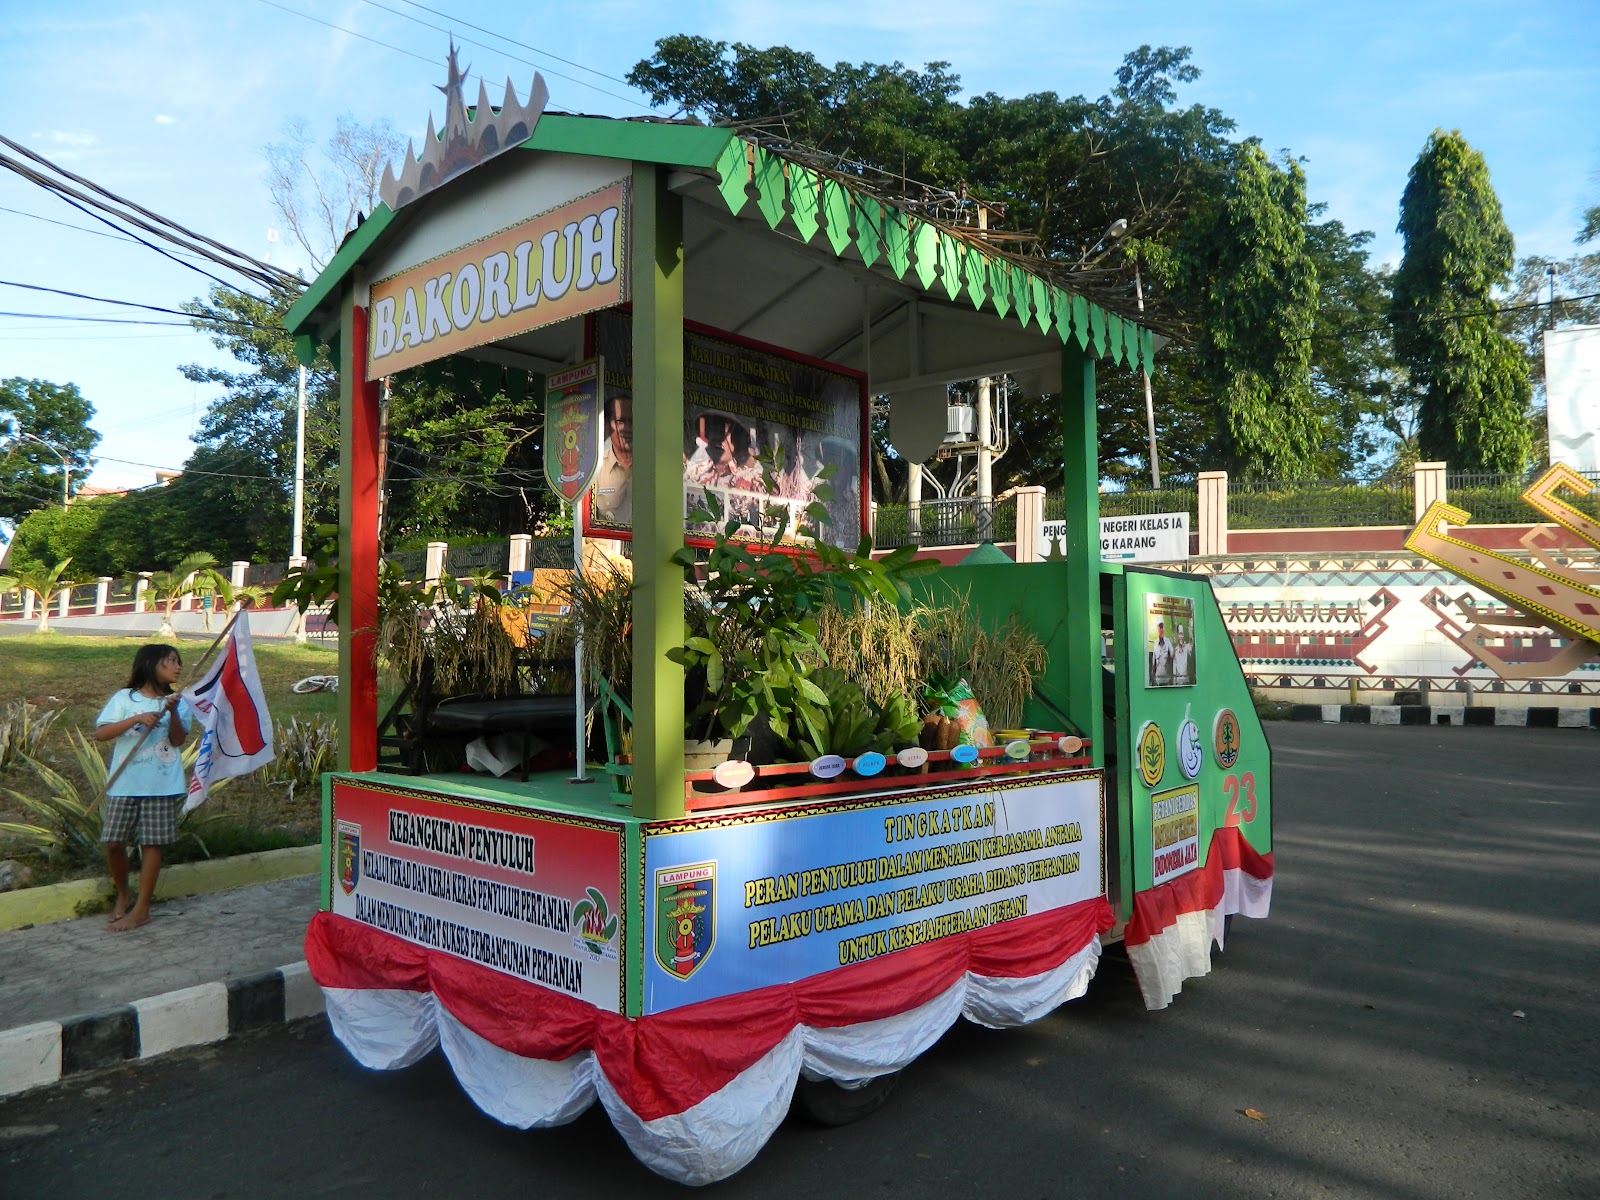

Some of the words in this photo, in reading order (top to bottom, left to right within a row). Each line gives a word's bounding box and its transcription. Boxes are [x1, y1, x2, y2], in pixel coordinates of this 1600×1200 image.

[373, 207, 619, 360] BAKORLUH
[551, 367, 593, 386] LAMPUNG
[690, 345, 713, 364] MARI
[716, 351, 736, 371] KITA
[740, 359, 792, 385] TINGKATKAN
[739, 404, 755, 419] DAN
[780, 392, 794, 406] DAN
[1104, 520, 1137, 533] NEGERI
[1140, 518, 1169, 531] KELAS
[1172, 517, 1182, 529] IA
[1112, 536, 1156, 550] KARANG
[884, 802, 994, 843] TINGKATKAN
[1222, 771, 1257, 828] 23
[389, 810, 467, 859] KEBANGKITAN
[468, 826, 535, 873] PENYULUH
[744, 872, 799, 908] PERAN
[801, 858, 877, 896] PENYULUH
[878, 851, 923, 881] DALAM
[924, 842, 981, 873] MENJALIN
[982, 829, 1043, 860] KERJASAMA
[1044, 822, 1082, 848] ANTARA
[363, 849, 389, 884] MELALUI
[390, 857, 411, 889] TEKAD
[412, 862, 427, 894] DAN
[428, 867, 451, 901] KERJA
[452, 872, 477, 908] KERAS
[478, 880, 520, 920] PENYULUH
[521, 889, 570, 933] PERTANIAN
[663, 869, 709, 883] LAMPUNG
[749, 910, 812, 949] PELAKU
[814, 897, 864, 932] UTAMA
[866, 891, 896, 921] DAN
[896, 879, 946, 915] PELAKU
[946, 872, 985, 901] USAHA
[986, 862, 1026, 892] BIDANG
[1026, 852, 1080, 882] PERTANIAN
[355, 893, 376, 926] DALAM
[377, 900, 418, 940] MENDUKUNG
[418, 913, 440, 948] EMPAT
[442, 920, 470, 957] SUKSES
[470, 929, 531, 977] PEMBANGUNAN
[532, 947, 582, 994] PERTANIAN
[838, 929, 887, 965] UNTUK
[888, 904, 989, 951] KESEJAHTERAAN
[990, 895, 1028, 924] PETANI
